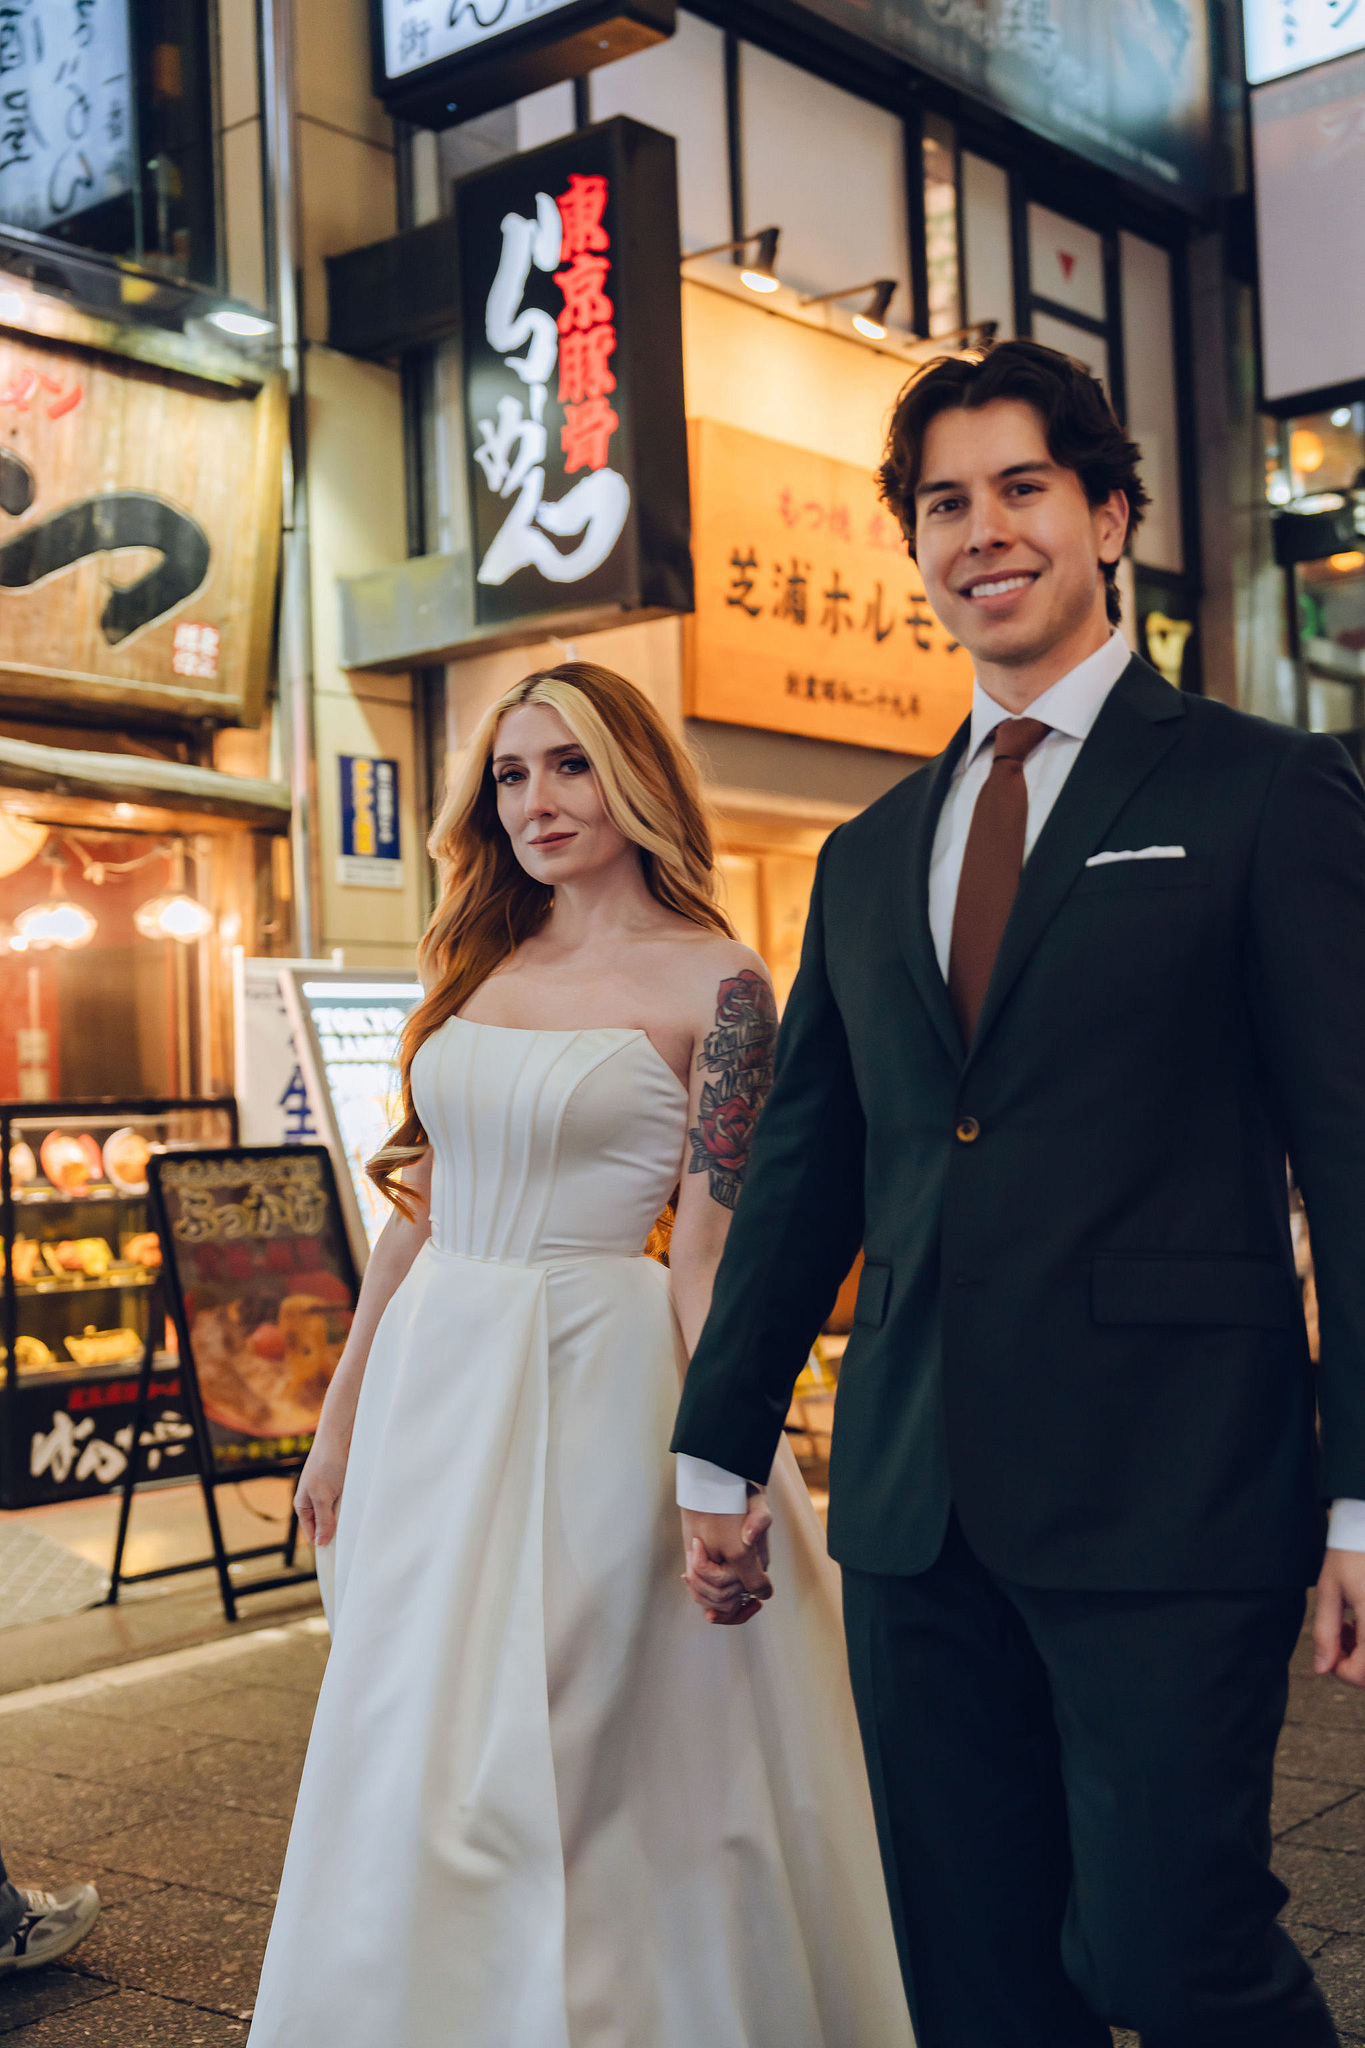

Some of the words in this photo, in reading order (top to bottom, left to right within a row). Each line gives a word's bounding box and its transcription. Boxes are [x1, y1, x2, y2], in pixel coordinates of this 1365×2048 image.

[474, 191, 631, 585] らーめん
[553, 173, 619, 474] 東京豚骨
[726, 546, 961, 653] 芝浦ホルモ
